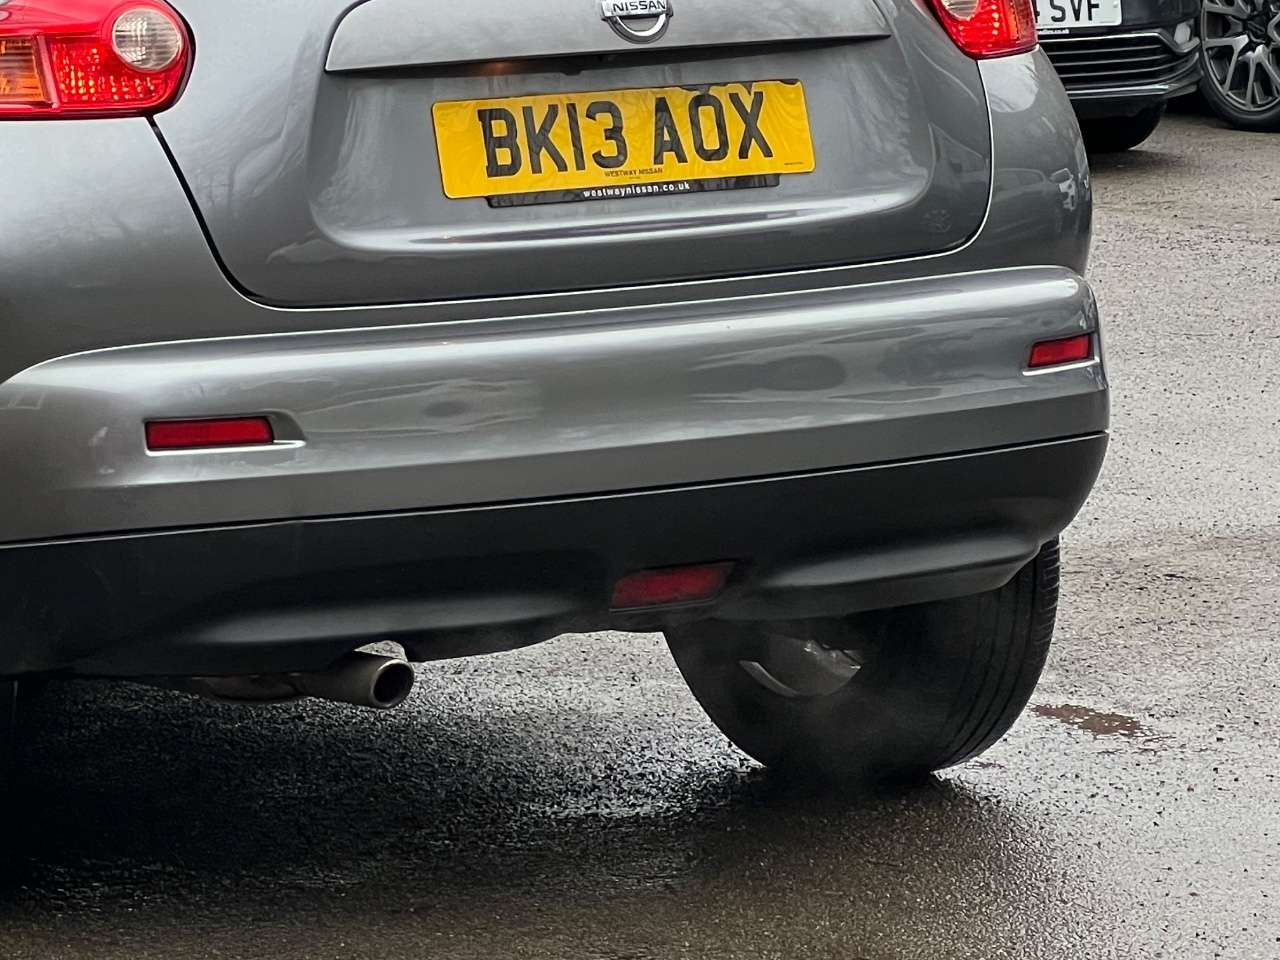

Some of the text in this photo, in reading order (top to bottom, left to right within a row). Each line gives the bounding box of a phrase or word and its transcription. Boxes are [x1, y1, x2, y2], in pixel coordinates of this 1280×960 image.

[612, 0, 667, 13] NISSAN
[477, 91, 774, 178] BK13 AOX
[604, 169, 638, 178] WESTWAY
[638, 167, 664, 175] NISSAN
[583, 181, 691, 198] westwaynissan.co.uk
